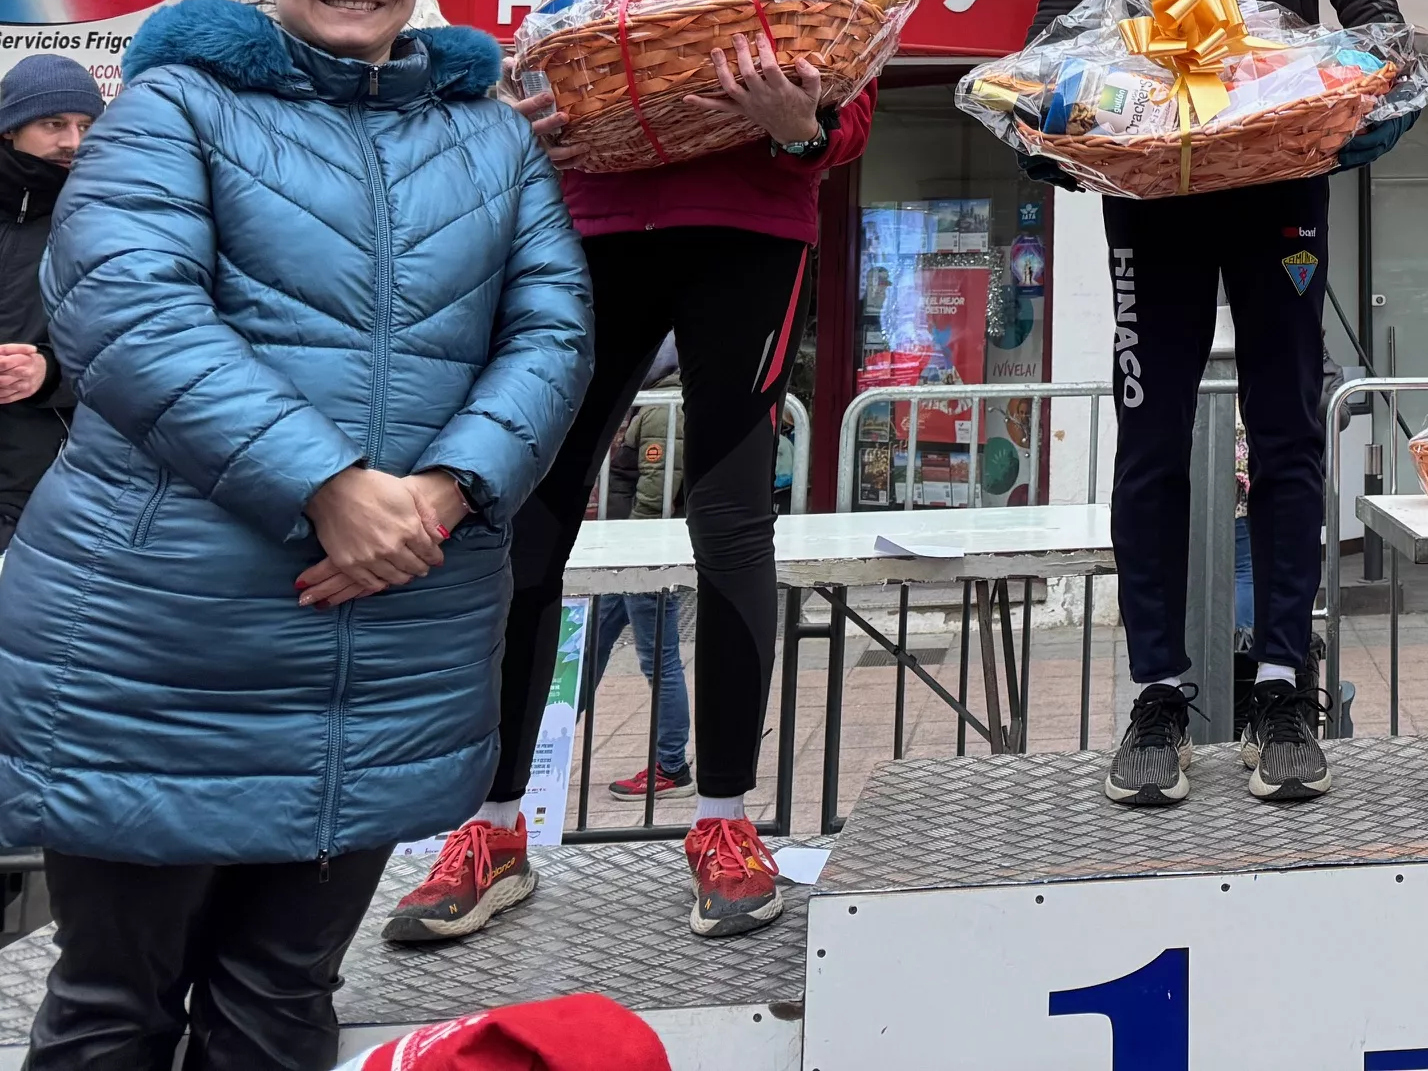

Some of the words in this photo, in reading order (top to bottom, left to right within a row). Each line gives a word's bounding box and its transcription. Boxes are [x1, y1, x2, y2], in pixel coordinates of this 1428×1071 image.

[1113, 88, 1127, 115] gullón
[1125, 79, 1154, 135] Crackers
[925, 306, 957, 315] DESTINO
[1113, 248, 1144, 409] HINACO
[993, 361, 1037, 377] ¡VÍVELA!
